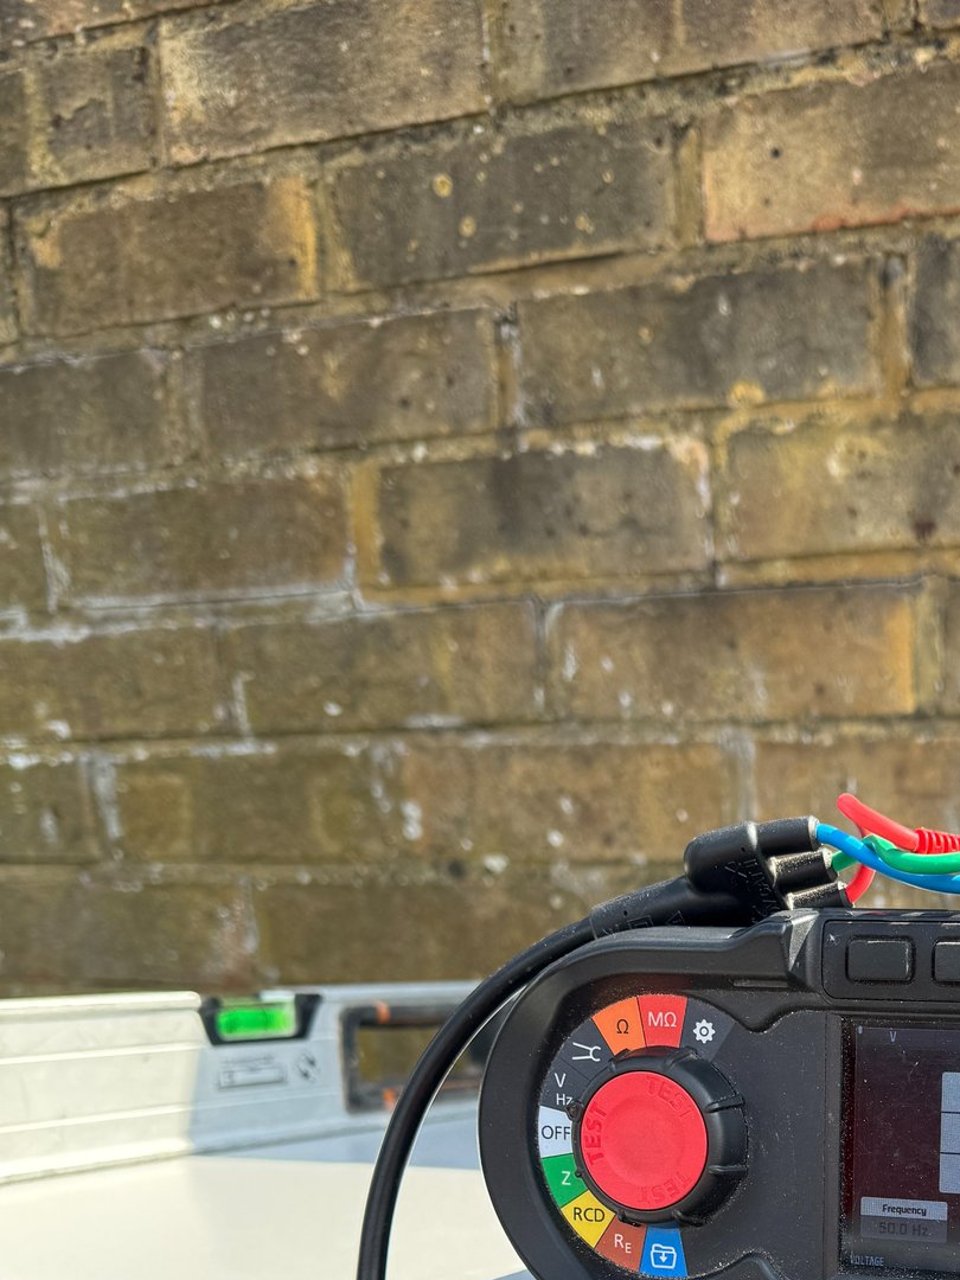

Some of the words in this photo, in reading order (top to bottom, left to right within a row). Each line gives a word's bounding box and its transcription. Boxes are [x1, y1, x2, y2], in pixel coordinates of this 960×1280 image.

[647, 1011, 677, 1028] MΩ
[554, 1071, 567, 1088] V
[541, 1124, 572, 1141] OFF
[561, 1171, 571, 1186] Z
[572, 1206, 606, 1223] RCD
[882, 1203, 927, 1217] Frequency
